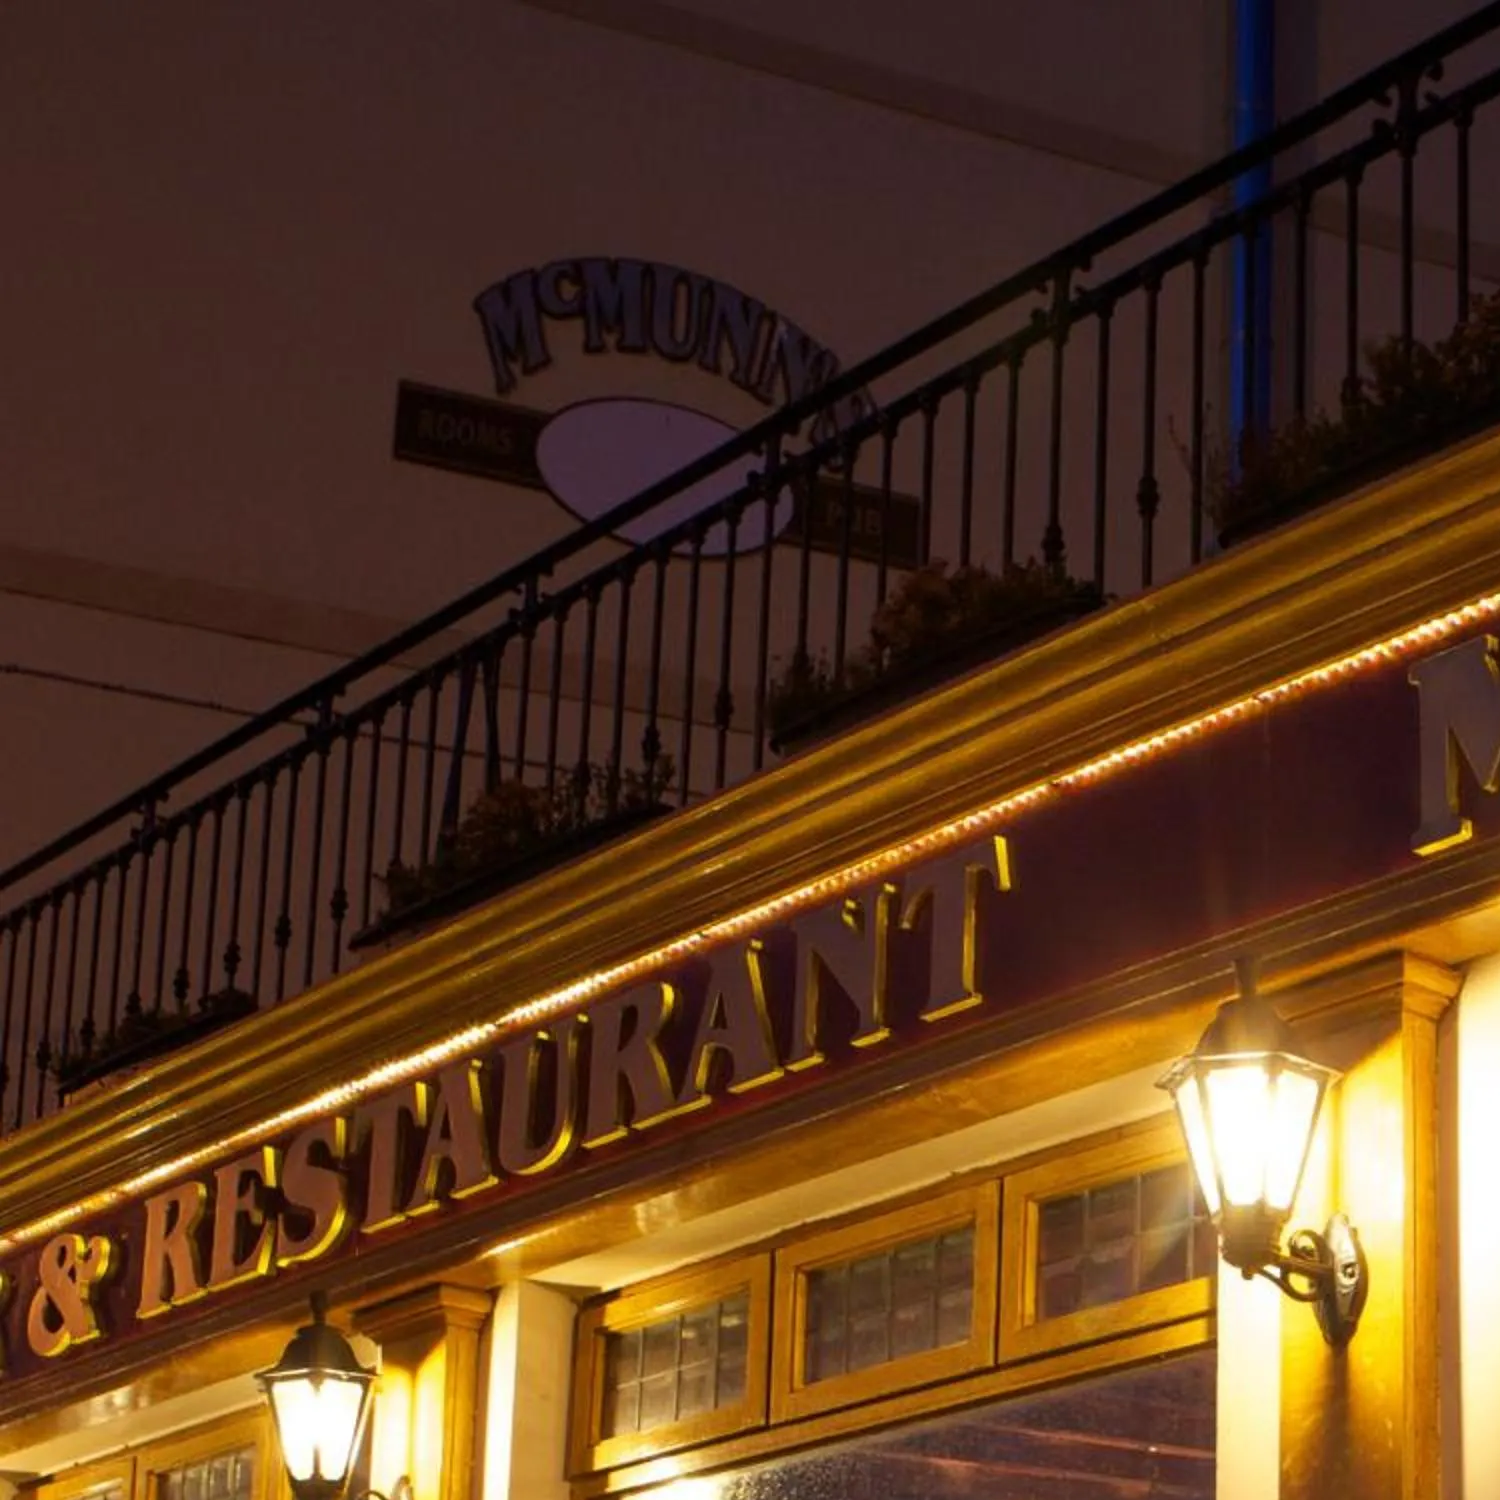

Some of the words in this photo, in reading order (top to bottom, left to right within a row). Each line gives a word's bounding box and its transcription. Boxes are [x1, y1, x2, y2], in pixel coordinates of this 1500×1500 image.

[416, 407, 515, 456] ROOMS
[27, 1233, 111, 1358] &
[136, 835, 1014, 1319] RESTAURANT
